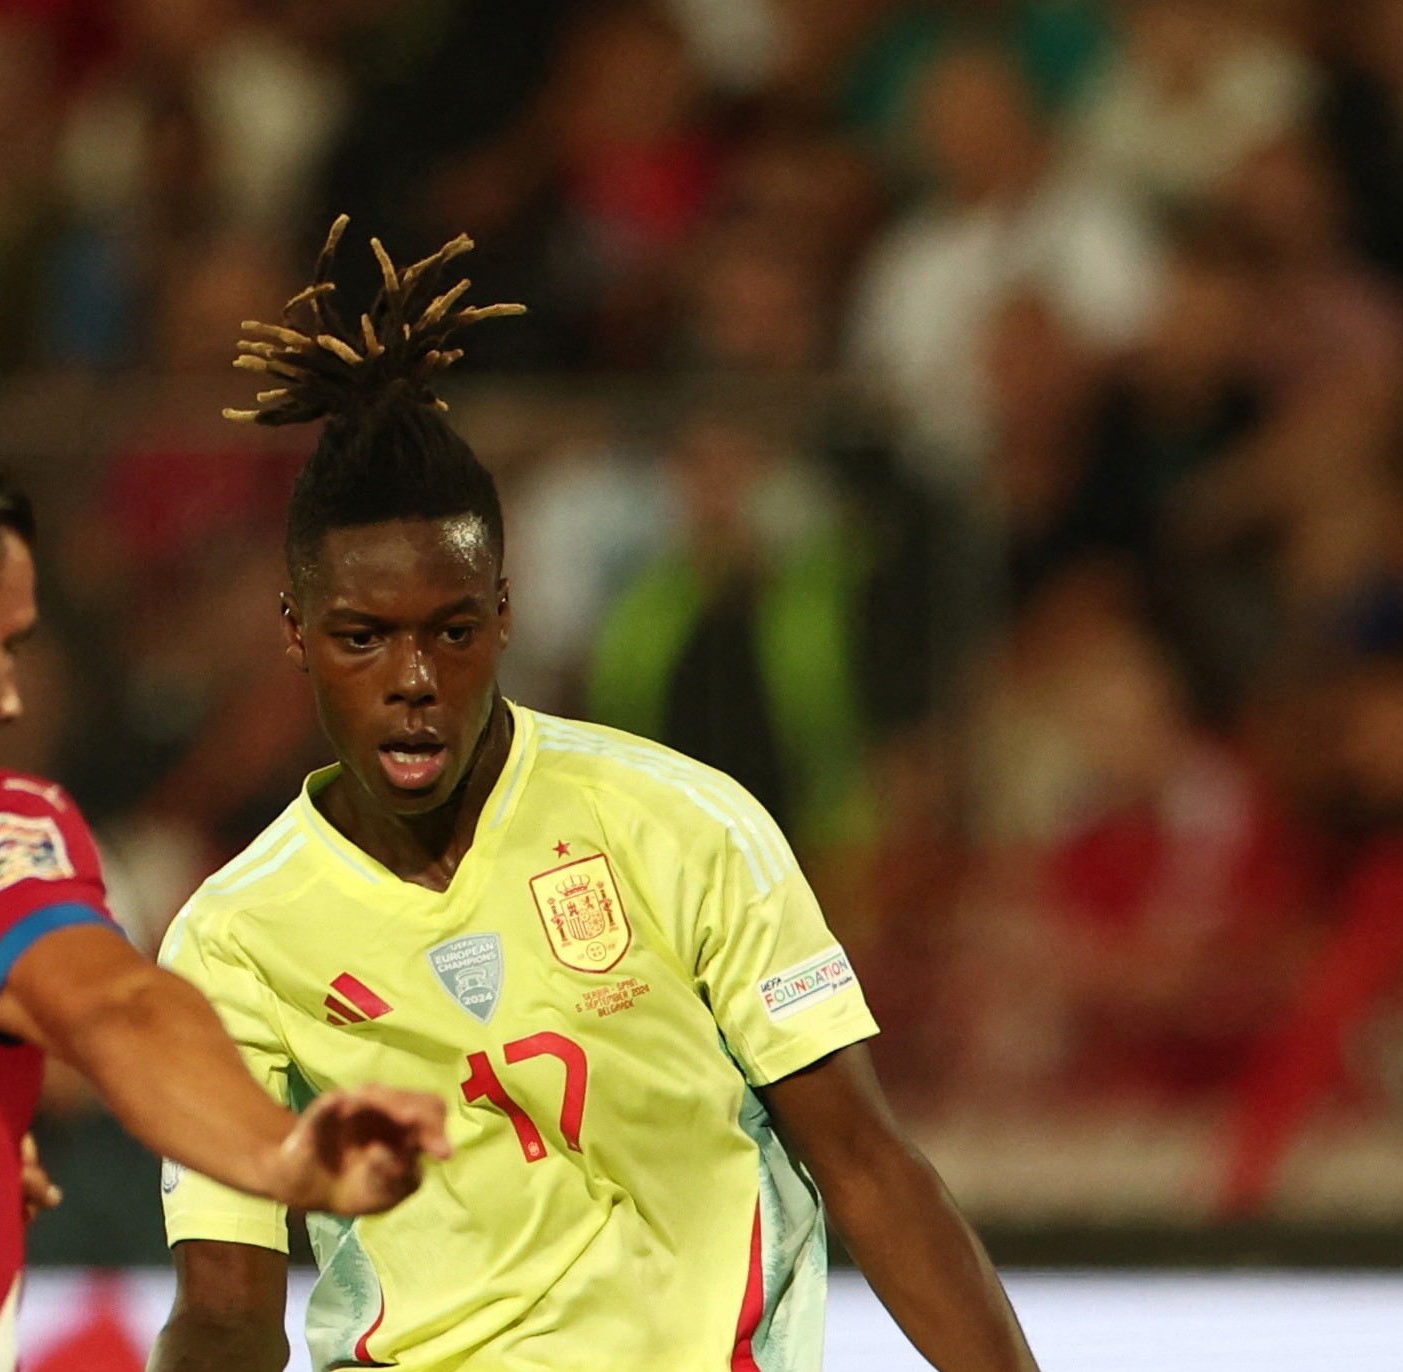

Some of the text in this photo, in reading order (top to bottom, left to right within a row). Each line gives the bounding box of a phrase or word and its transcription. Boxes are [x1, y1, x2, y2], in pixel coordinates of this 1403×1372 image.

[435, 941, 495, 965] EUROPEAN
[450, 939, 475, 951] UEFA
[437, 950, 497, 973] CHAMPIONS
[631, 984, 651, 997] 2024
[760, 977, 782, 992] UEFA
[764, 957, 849, 1008] FOUNDATION
[464, 991, 494, 1006] 2024
[461, 1031, 588, 1163] 17
